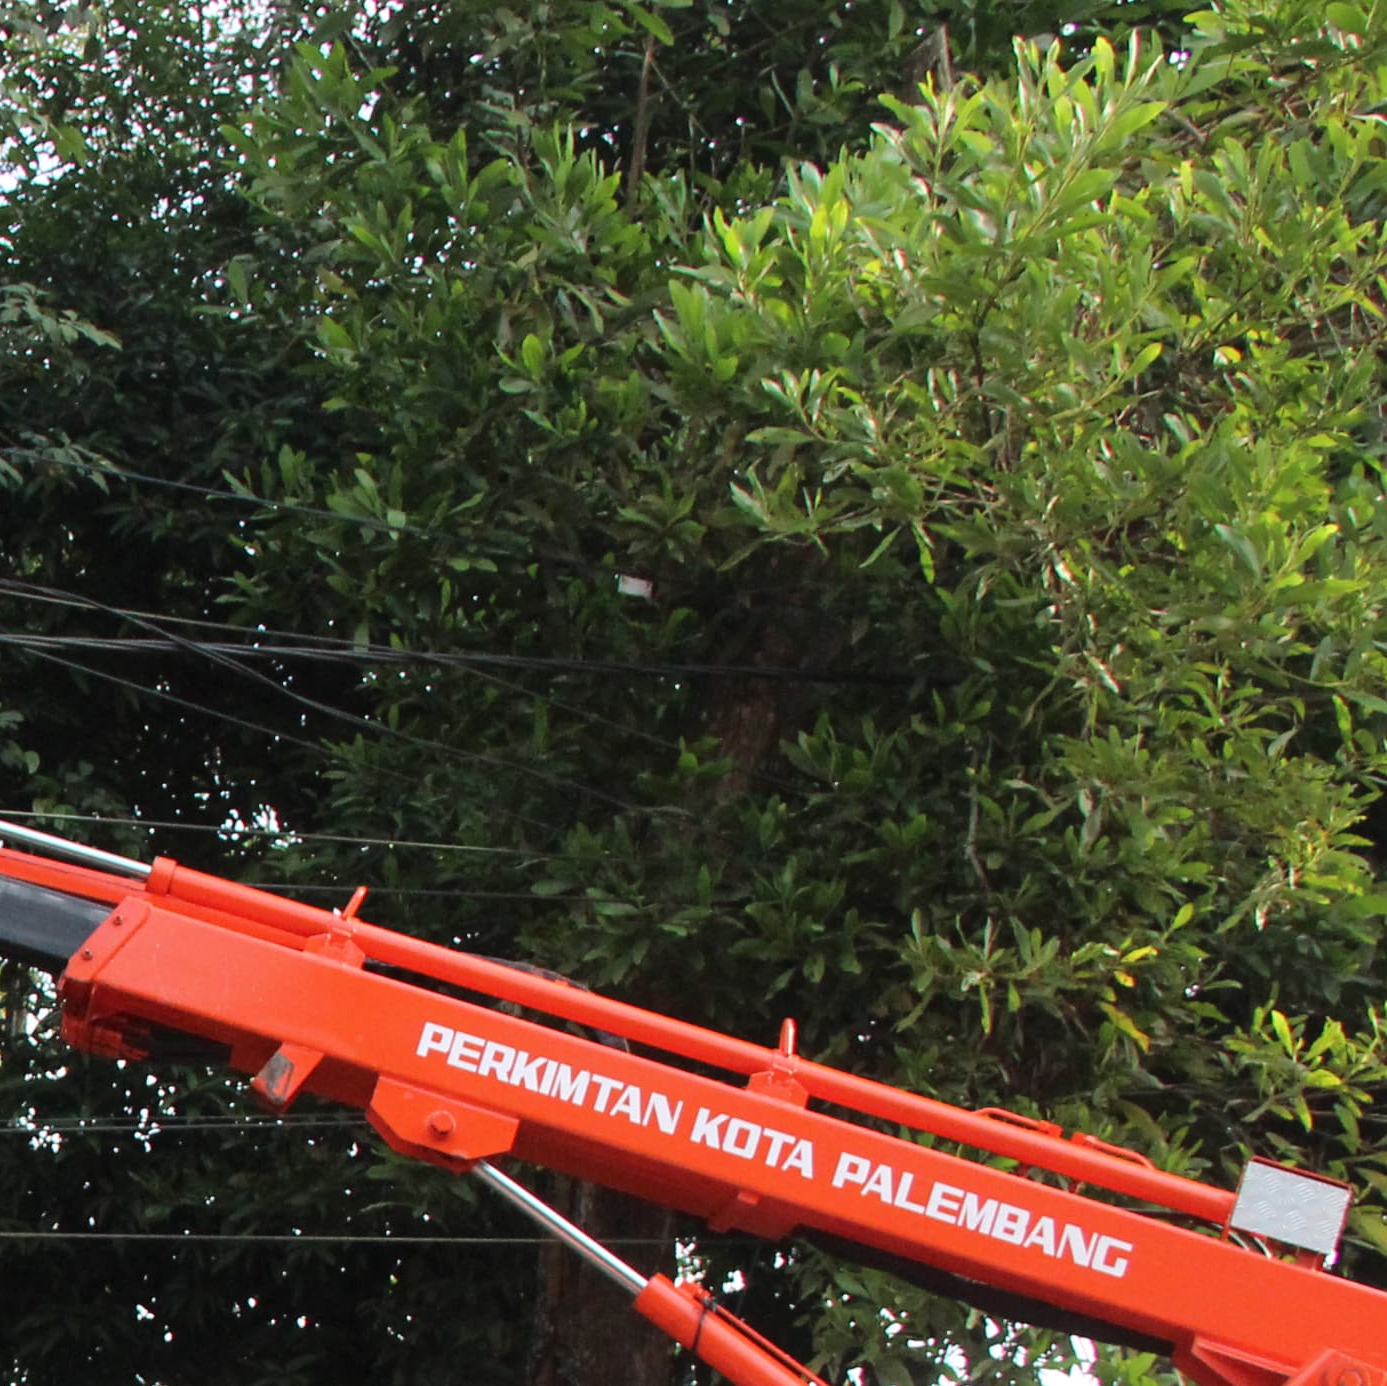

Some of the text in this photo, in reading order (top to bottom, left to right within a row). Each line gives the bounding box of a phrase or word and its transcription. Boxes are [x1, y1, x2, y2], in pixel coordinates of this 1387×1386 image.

[416, 1021, 1133, 1278] PERKIMTAN KOTA PALEMBANG
